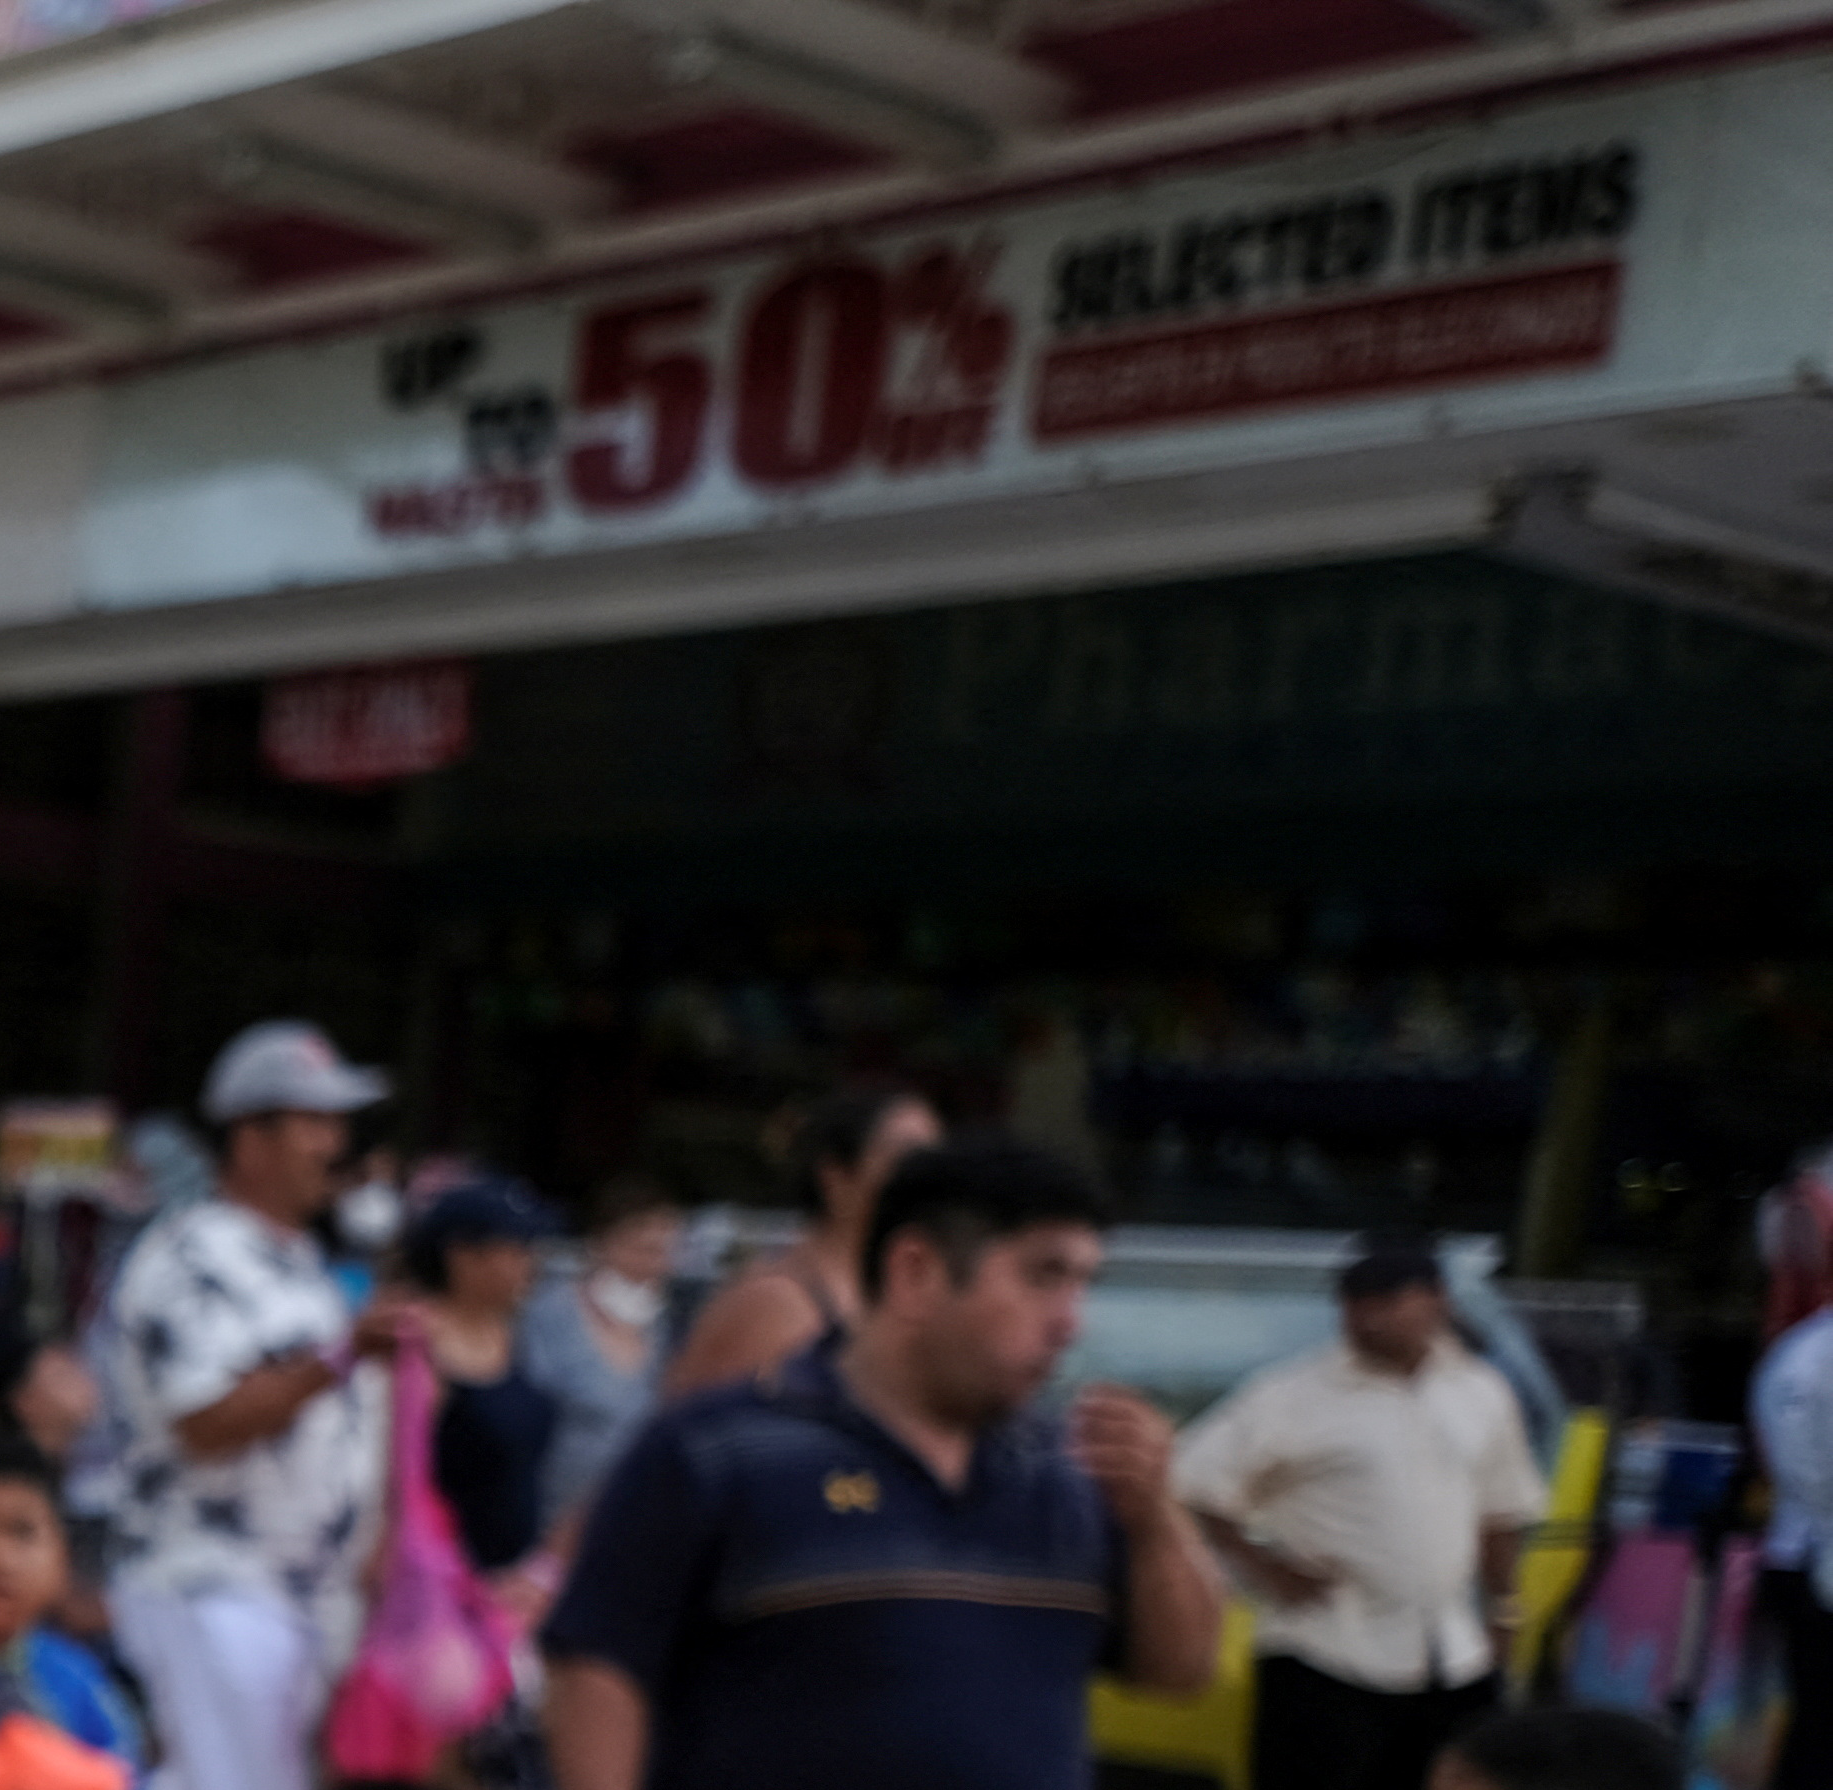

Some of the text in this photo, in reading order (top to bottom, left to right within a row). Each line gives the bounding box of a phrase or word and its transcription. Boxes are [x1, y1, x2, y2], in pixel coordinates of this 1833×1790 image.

[1052, 145, 1640, 327] SELECTED ITEMS
[379, 324, 484, 408] UP
[938, 588, 1831, 745] Pharmac
